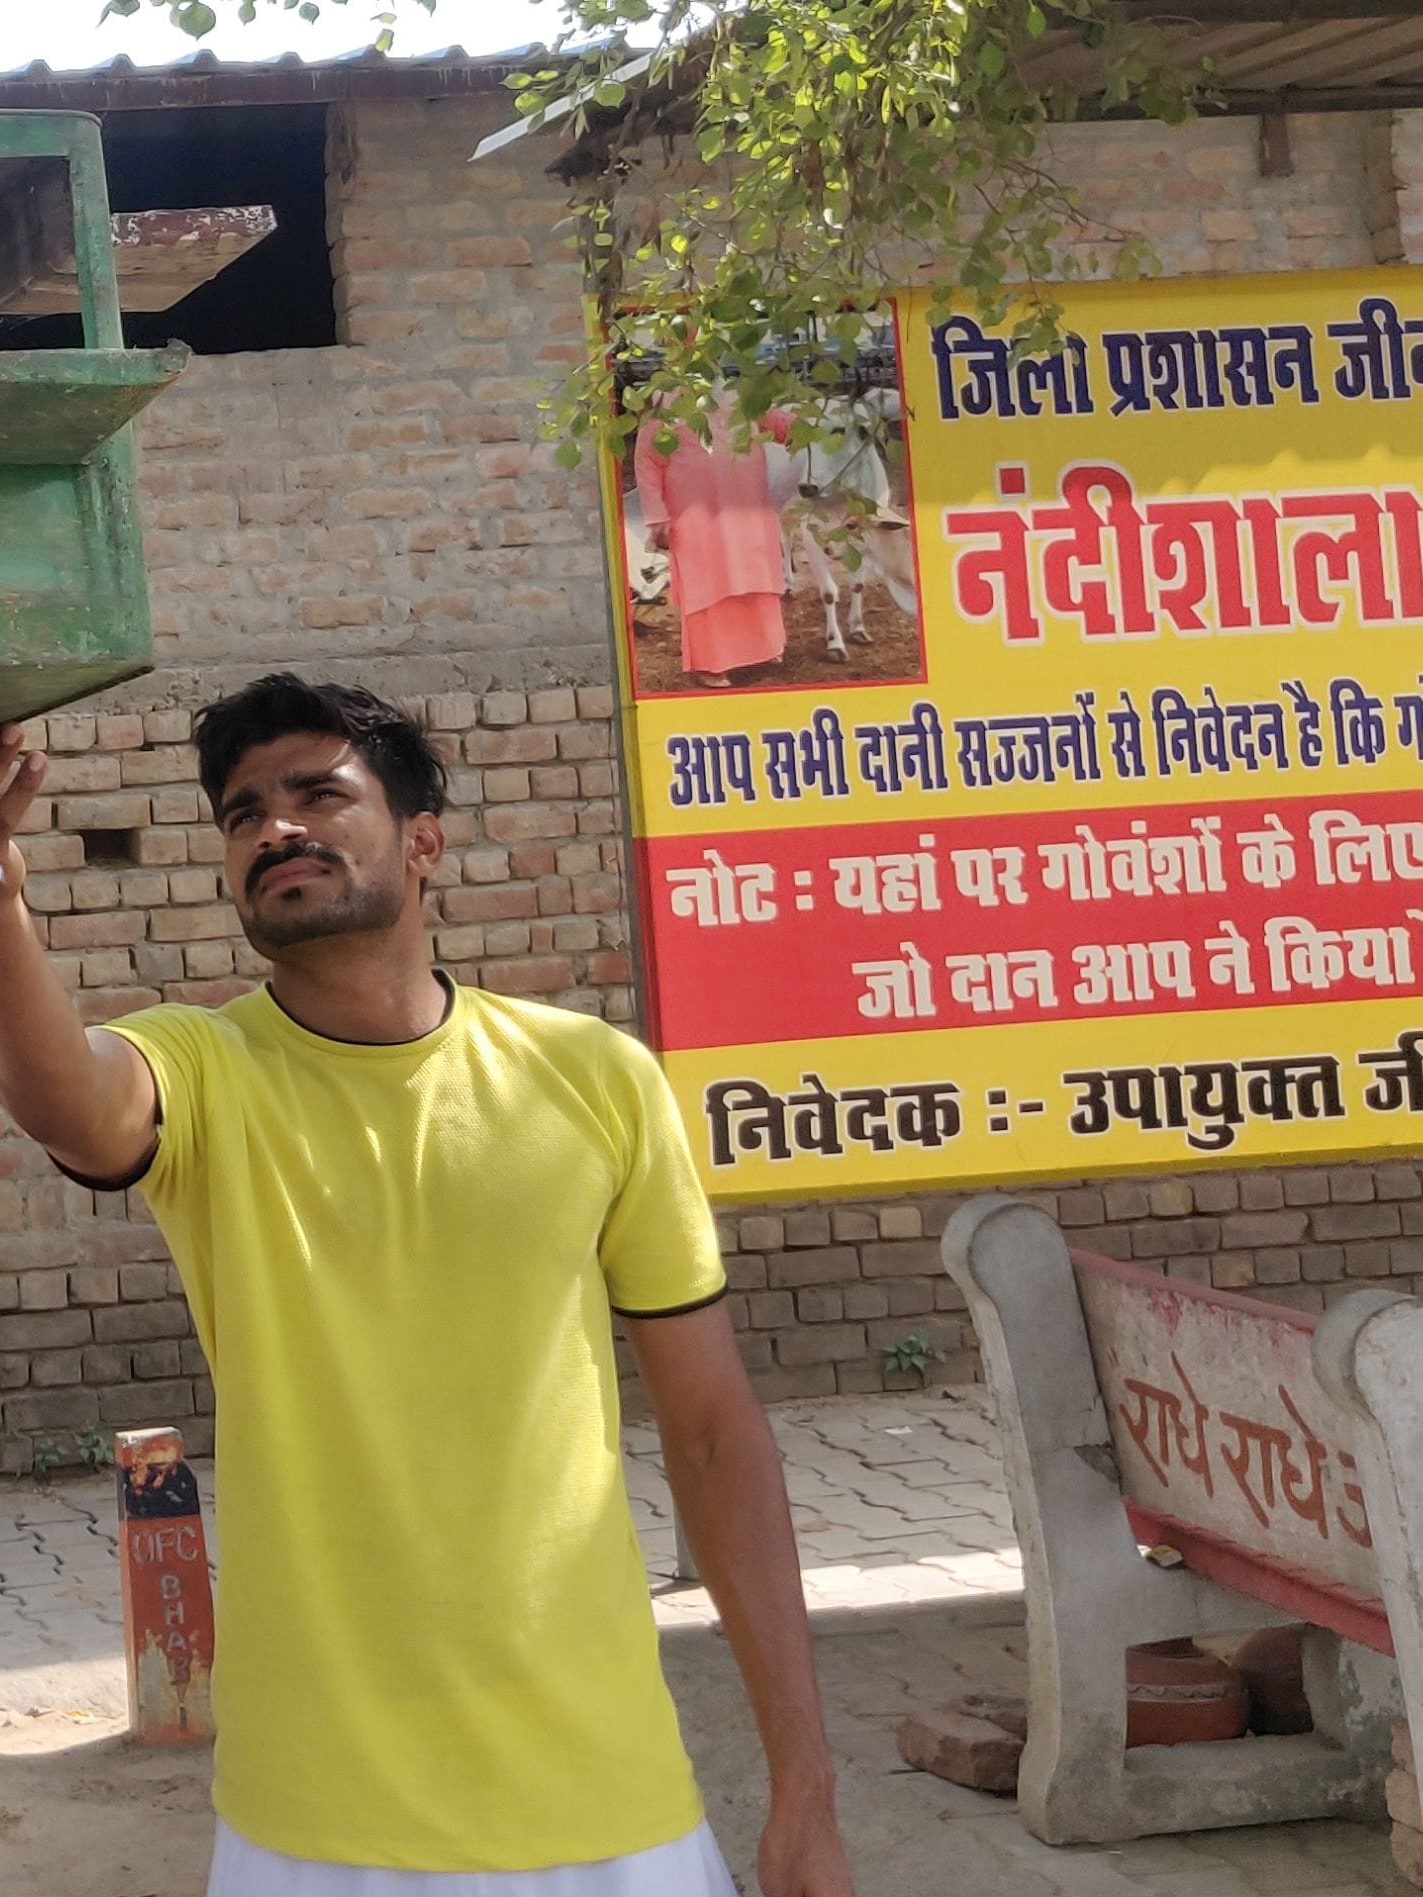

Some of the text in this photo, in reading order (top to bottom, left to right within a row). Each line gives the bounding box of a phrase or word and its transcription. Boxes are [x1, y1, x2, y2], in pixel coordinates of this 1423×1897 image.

[930, 315, 1095, 420] जिला
[1102, 324, 1321, 418] प्रशासन
[945, 464, 1423, 641] नंदीशाला
[666, 736, 756, 806] आप
[761, 707, 849, 799] सभी
[854, 702, 949, 792] दानी
[954, 691, 1101, 787] सज्जनों
[1107, 690, 1146, 778] से
[1151, 685, 1289, 776] निवेदन
[1280, 679, 1323, 767] है
[1329, 678, 1386, 765] कि
[665, 849, 777, 927] नोट
[828, 833, 942, 915] यहां
[950, 846, 1030, 907] पर
[1037, 815, 1227, 901] गोवंशों
[1235, 812, 1297, 889] के
[1307, 809, 1423, 886] लिए
[851, 915, 1416, 1018] जो दान आप ने किया
[704, 1073, 961, 1166] निवेदक
[1063, 1055, 1346, 1151] उपायुक्त
[1118, 1350, 1214, 1499] राधे
[1220, 1384, 1330, 1540] राधे
[131, 1525, 199, 1564] OFC
